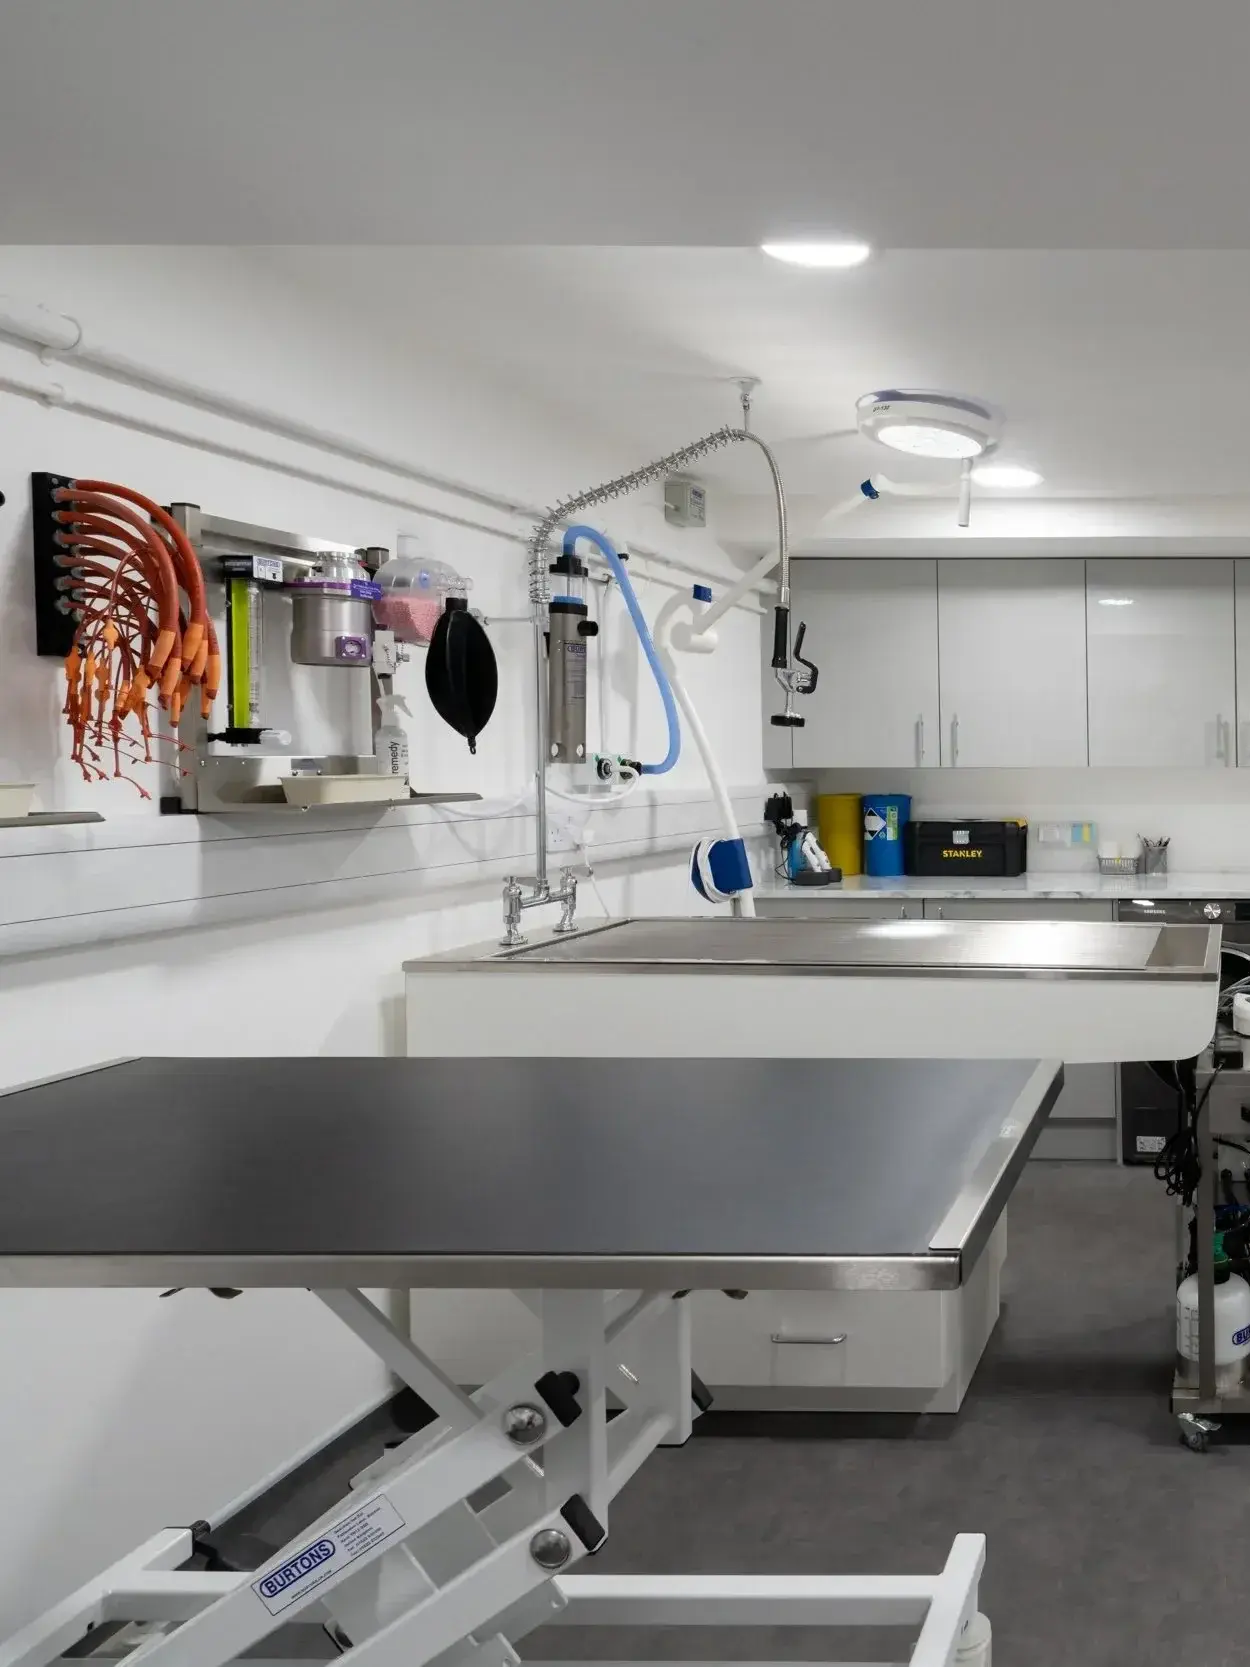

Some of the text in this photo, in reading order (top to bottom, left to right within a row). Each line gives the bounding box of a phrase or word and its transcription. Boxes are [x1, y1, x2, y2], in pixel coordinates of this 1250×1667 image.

[388, 741, 400, 774] remedy
[942, 850, 982, 858] STANLEY
[264, 1543, 331, 1595] BURTONS
